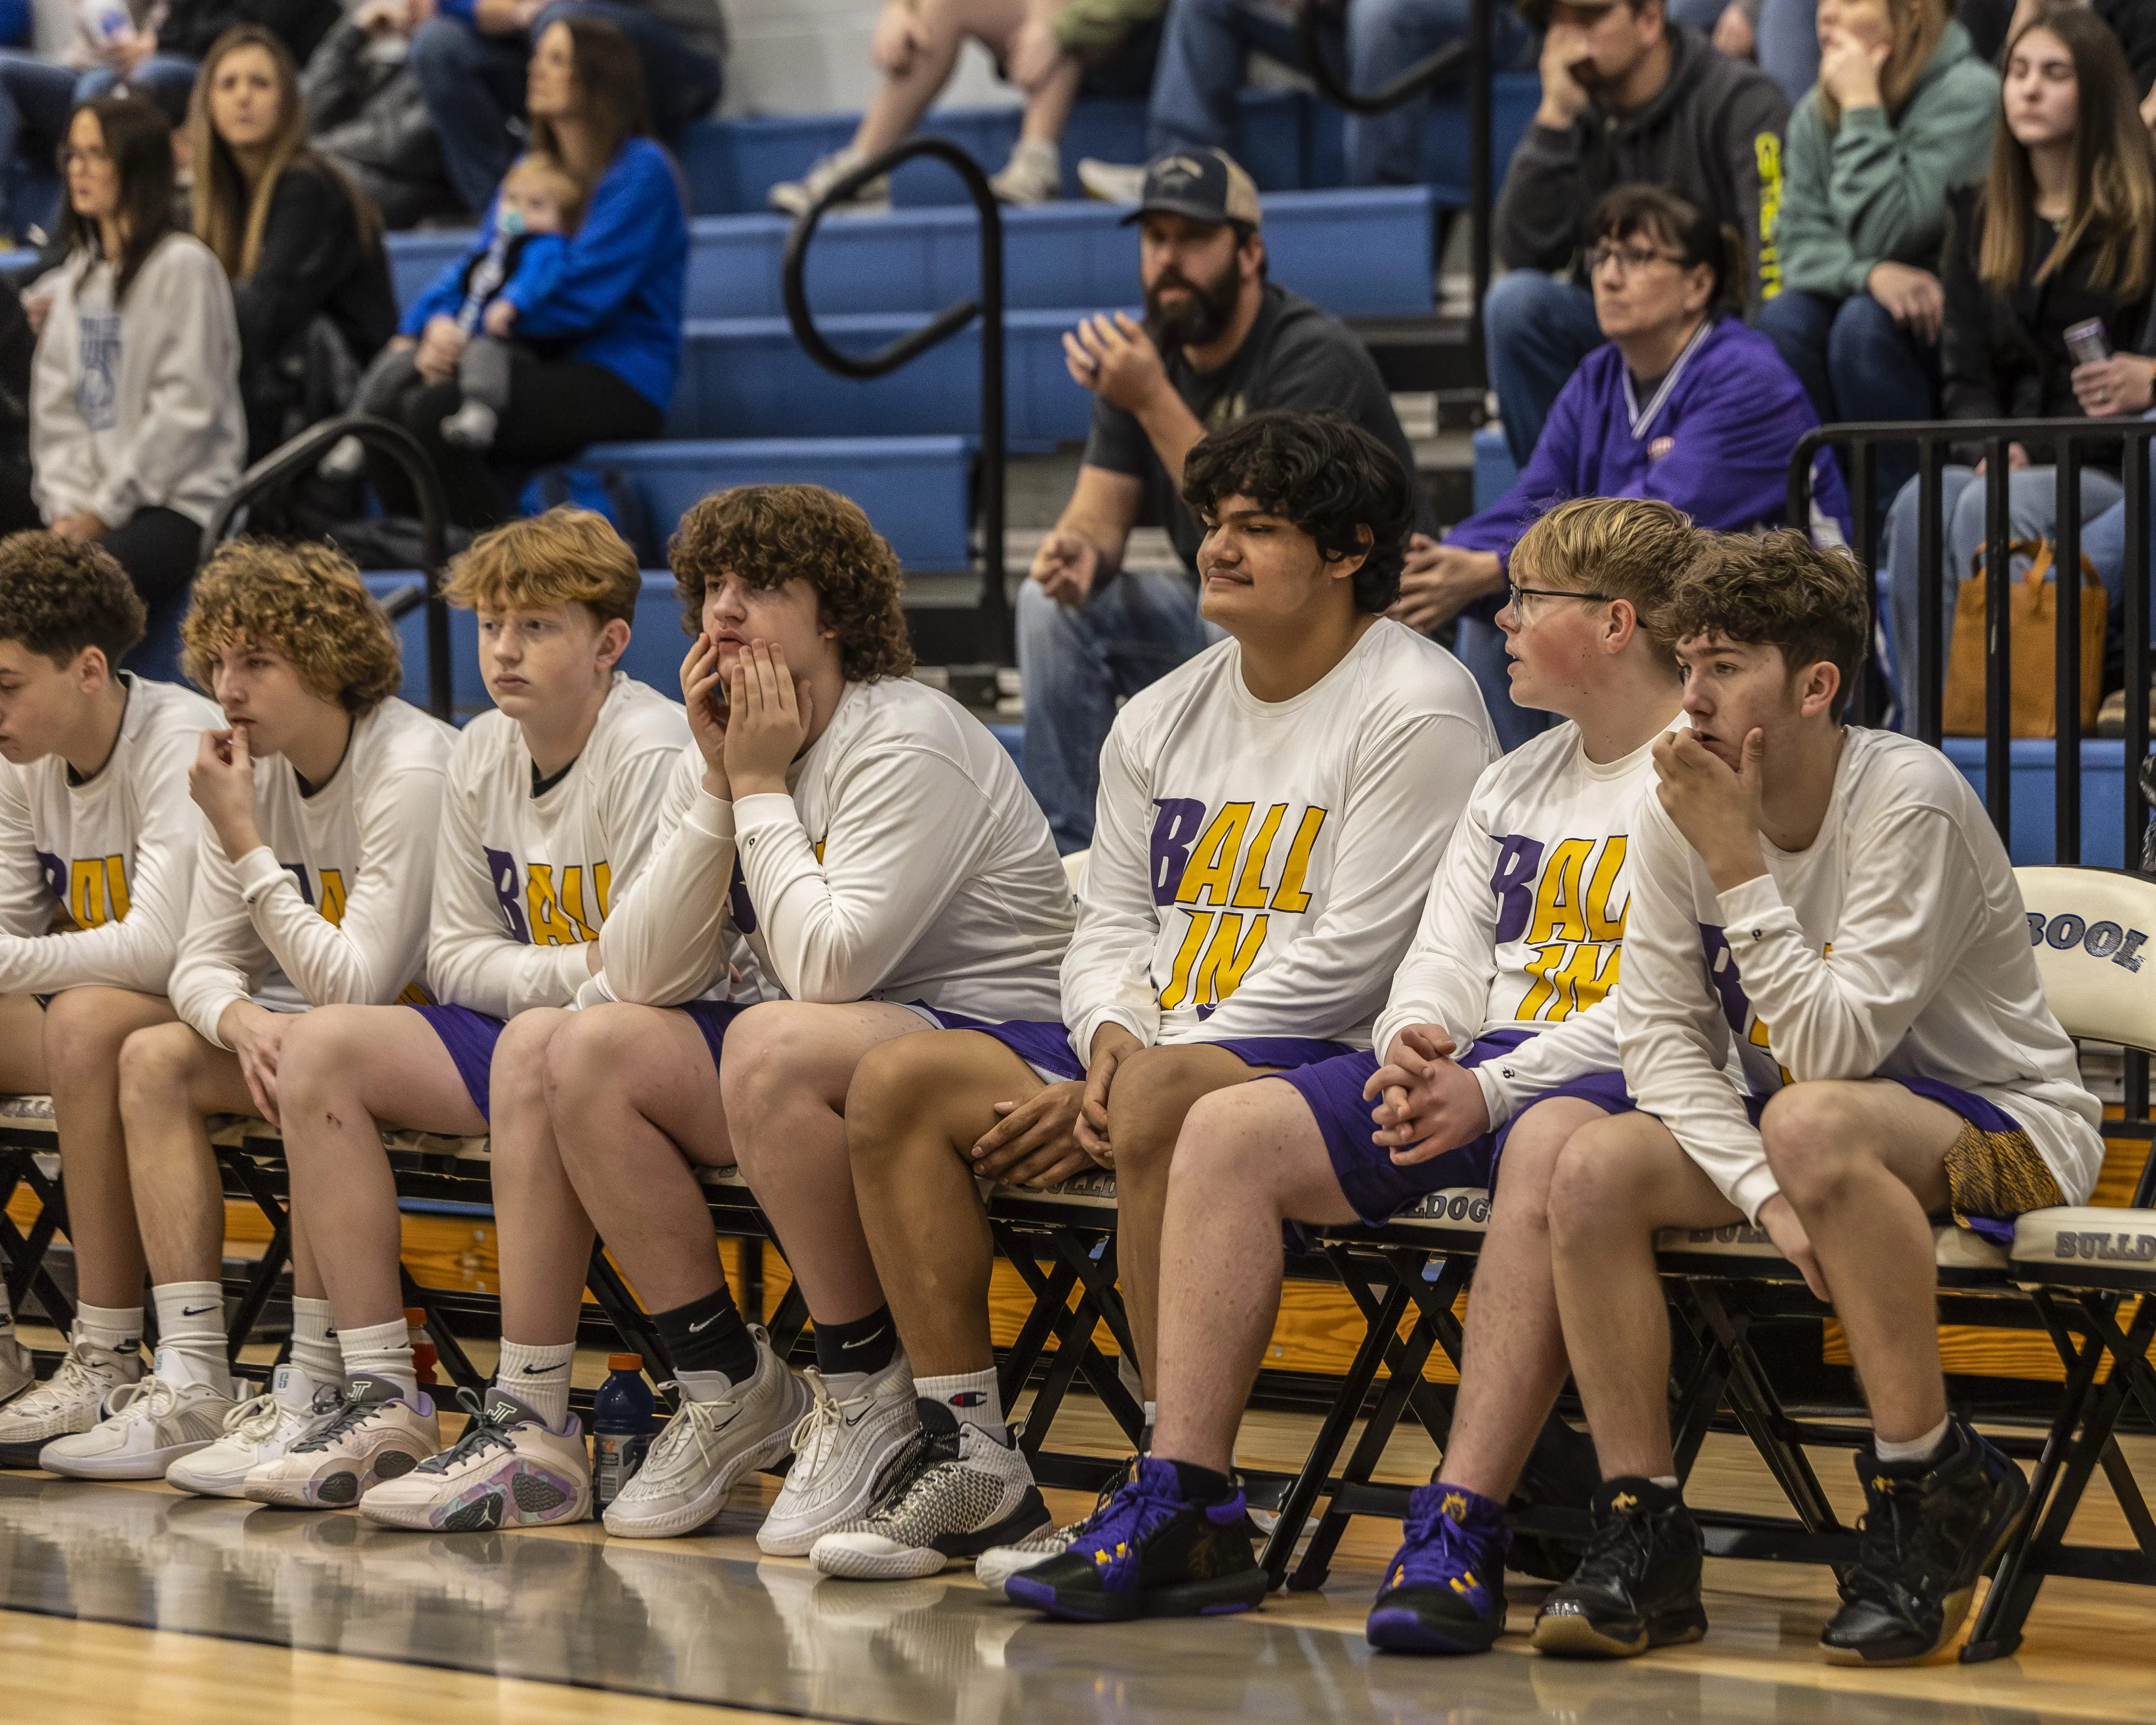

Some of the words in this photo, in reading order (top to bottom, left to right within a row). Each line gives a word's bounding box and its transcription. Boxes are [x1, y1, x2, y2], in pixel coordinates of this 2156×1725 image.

[1150, 797, 1328, 914] BALL
[1489, 834, 1632, 945] BAL
[1160, 907, 1270, 1011] IN
[1514, 942, 1623, 1022] IN
